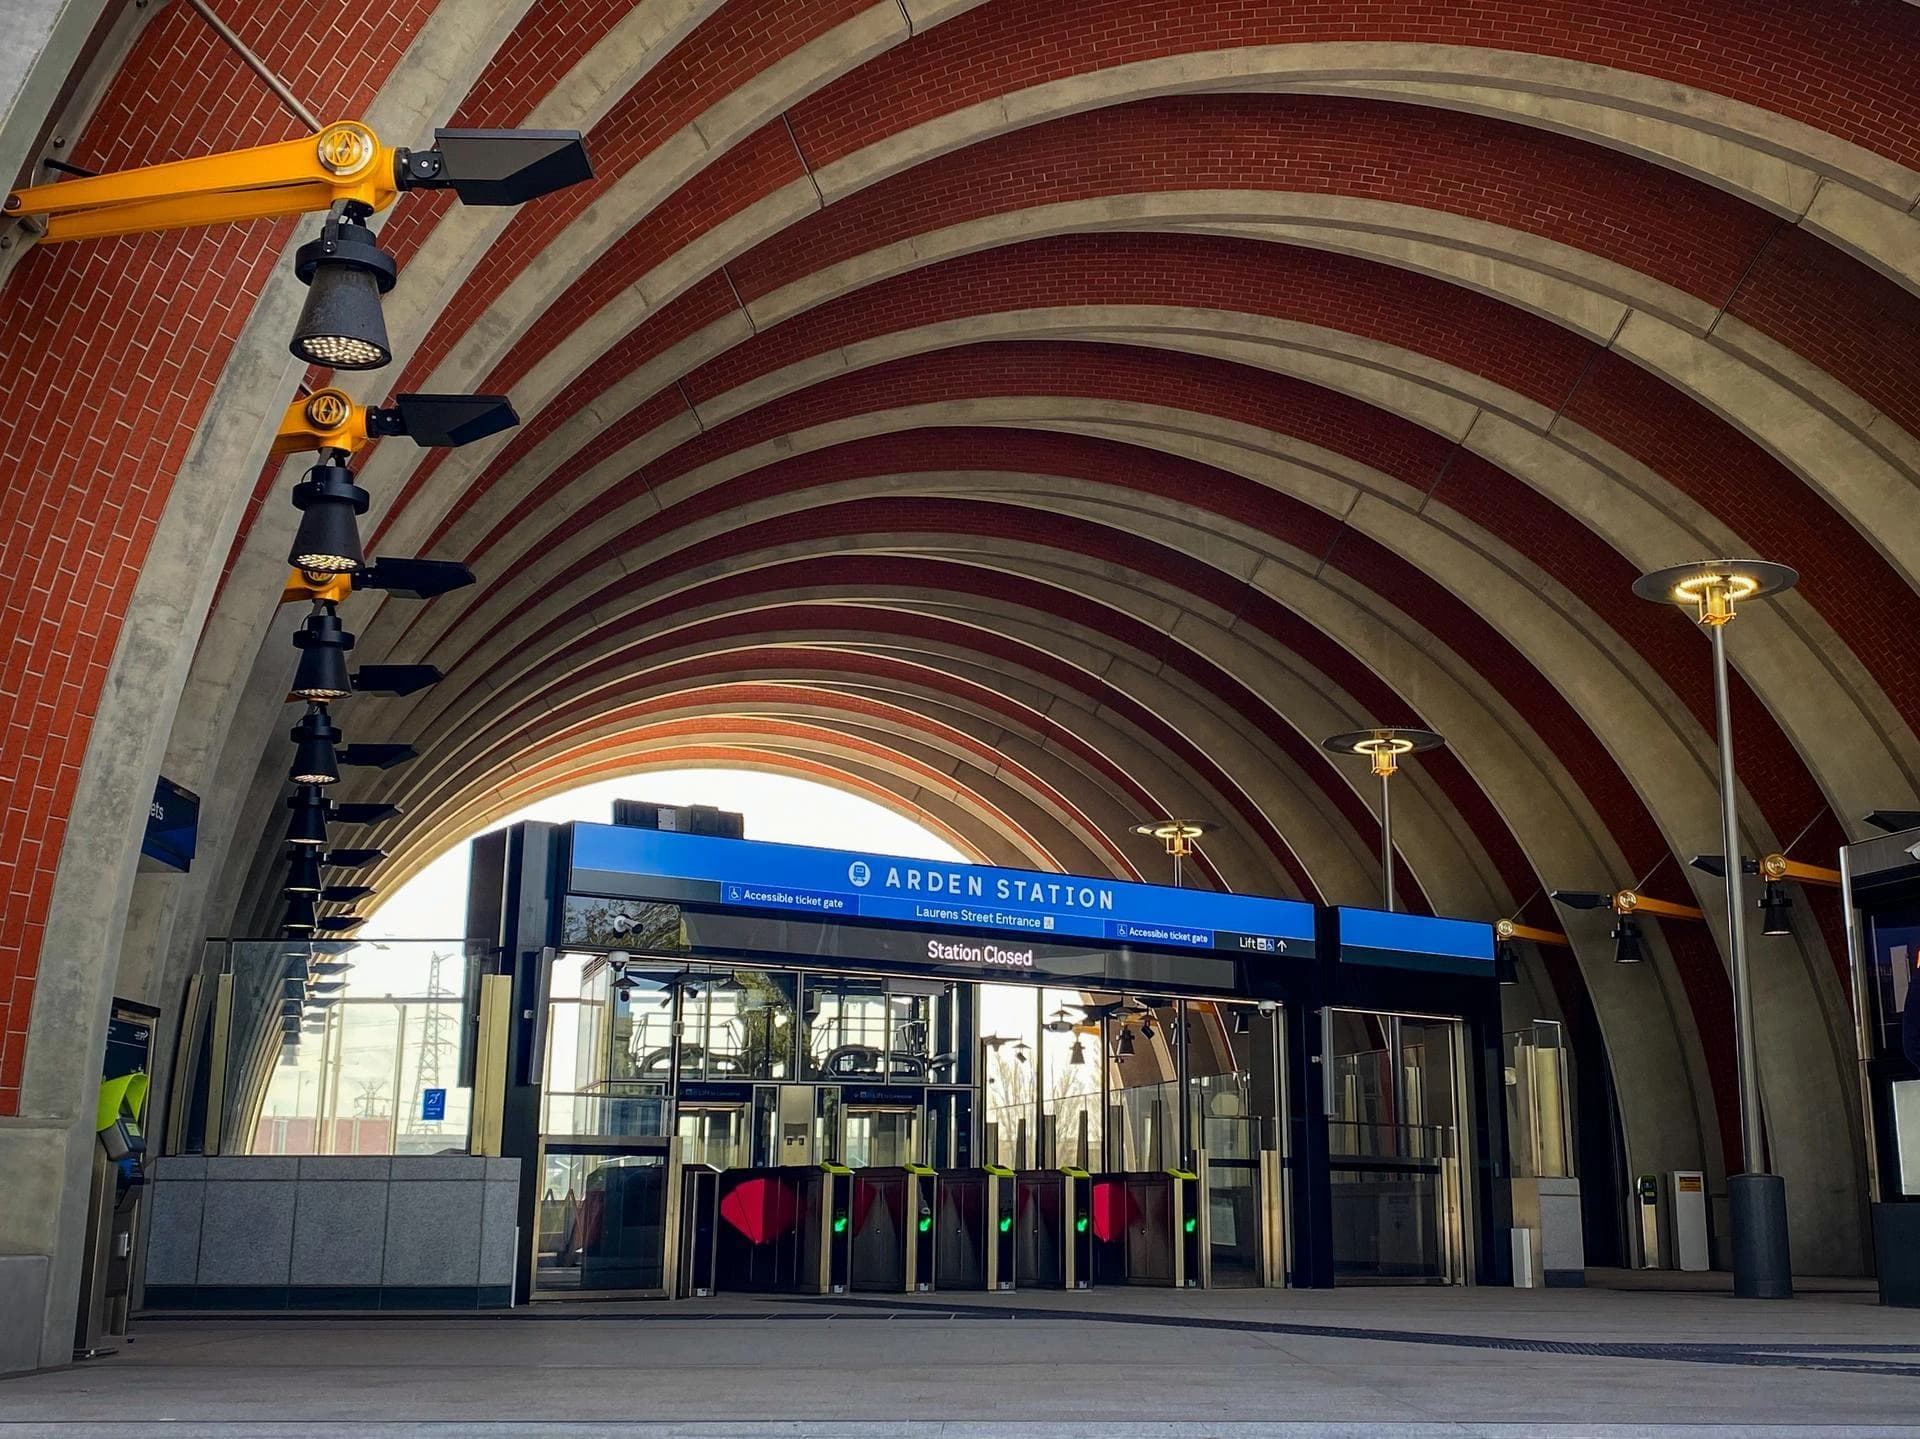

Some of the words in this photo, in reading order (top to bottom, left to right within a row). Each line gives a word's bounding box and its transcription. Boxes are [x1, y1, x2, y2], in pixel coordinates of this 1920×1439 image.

[743, 889, 793, 904] Accessible
[795, 894, 821, 906] ticket
[823, 899, 843, 909] gate
[886, 867, 982, 897] ARDEN
[997, 879, 1113, 910] STATION
[916, 905, 959, 920] Laurens
[961, 909, 994, 924] Street
[996, 913, 1041, 928] Entrance
[1129, 926, 1168, 939] Accessible
[1170, 930, 1190, 941] ticket
[1192, 934, 1208, 944] gate
[1239, 936, 1256, 949] Lift
[927, 940, 981, 962] Station
[983, 945, 1033, 966] Closed
